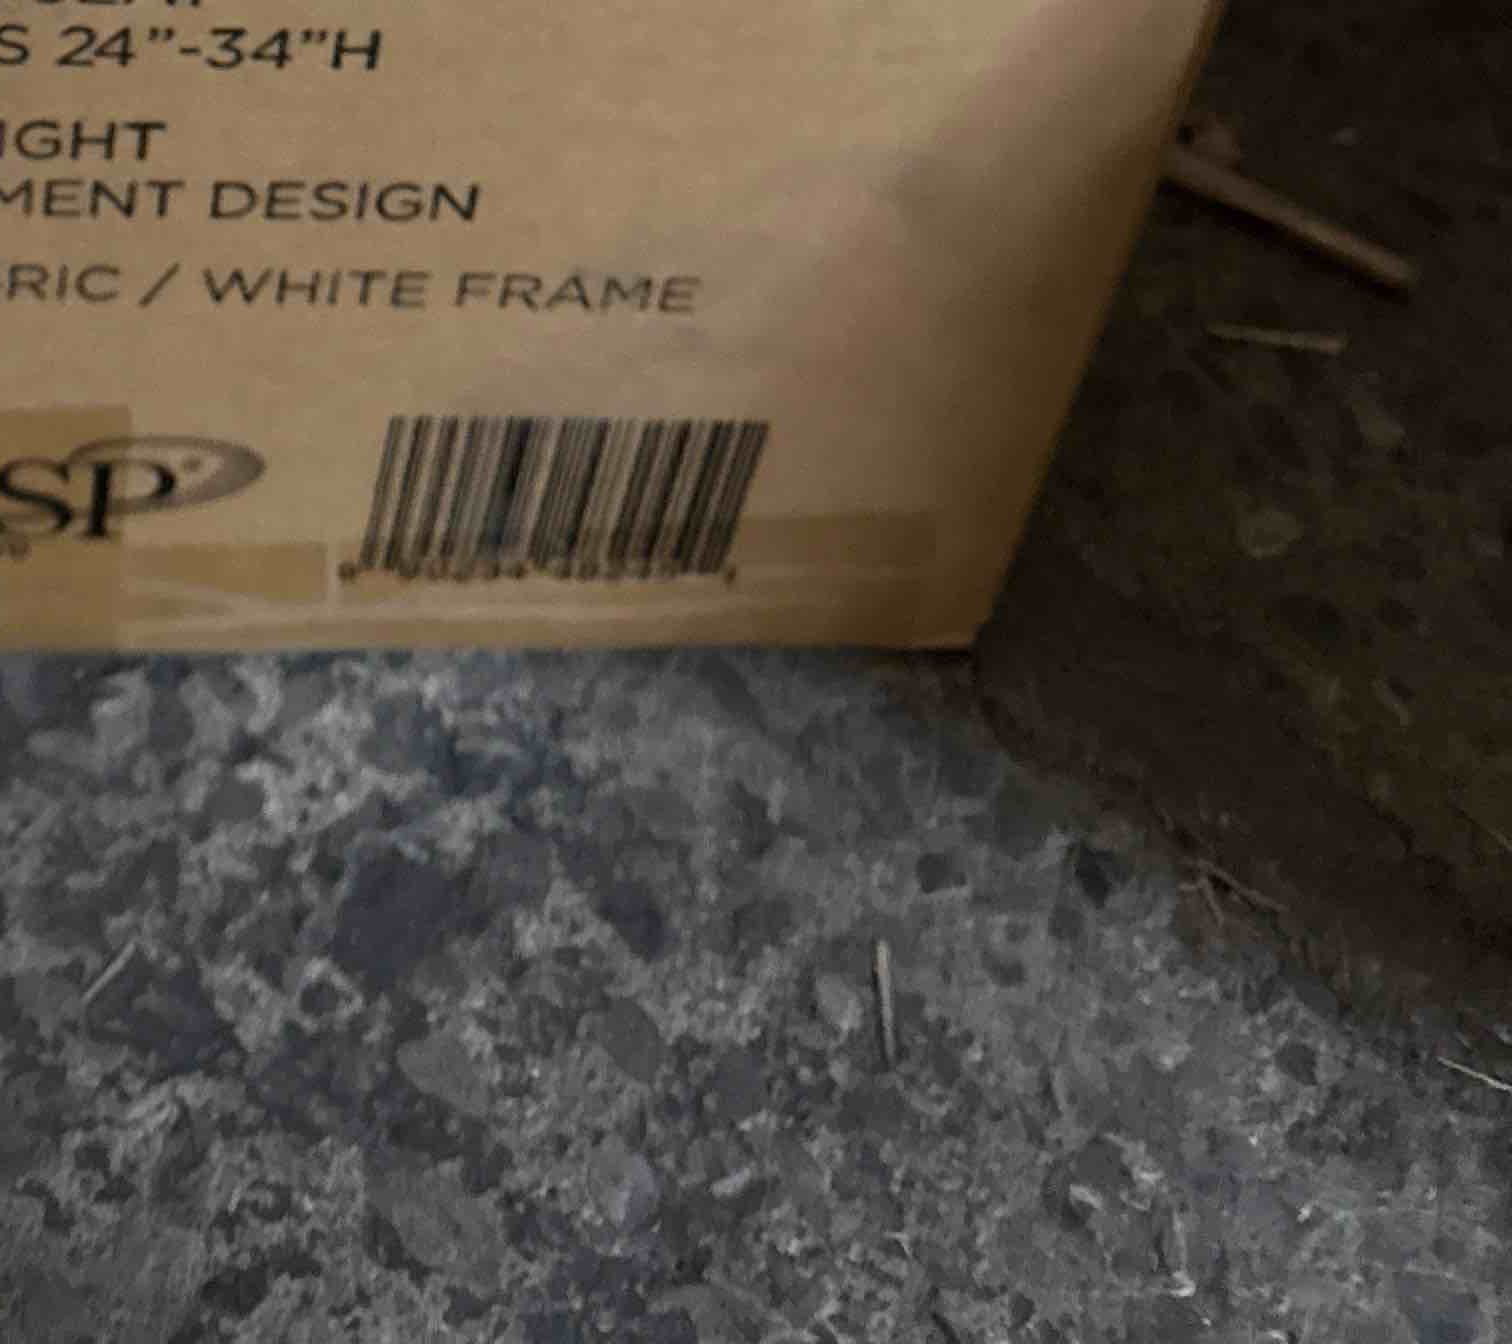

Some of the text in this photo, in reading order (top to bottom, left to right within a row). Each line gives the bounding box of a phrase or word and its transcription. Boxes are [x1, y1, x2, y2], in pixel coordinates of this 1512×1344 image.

[209, 179, 481, 224] DESIGN
[202, 267, 429, 310] WHITE
[453, 270, 702, 314] FRAME
